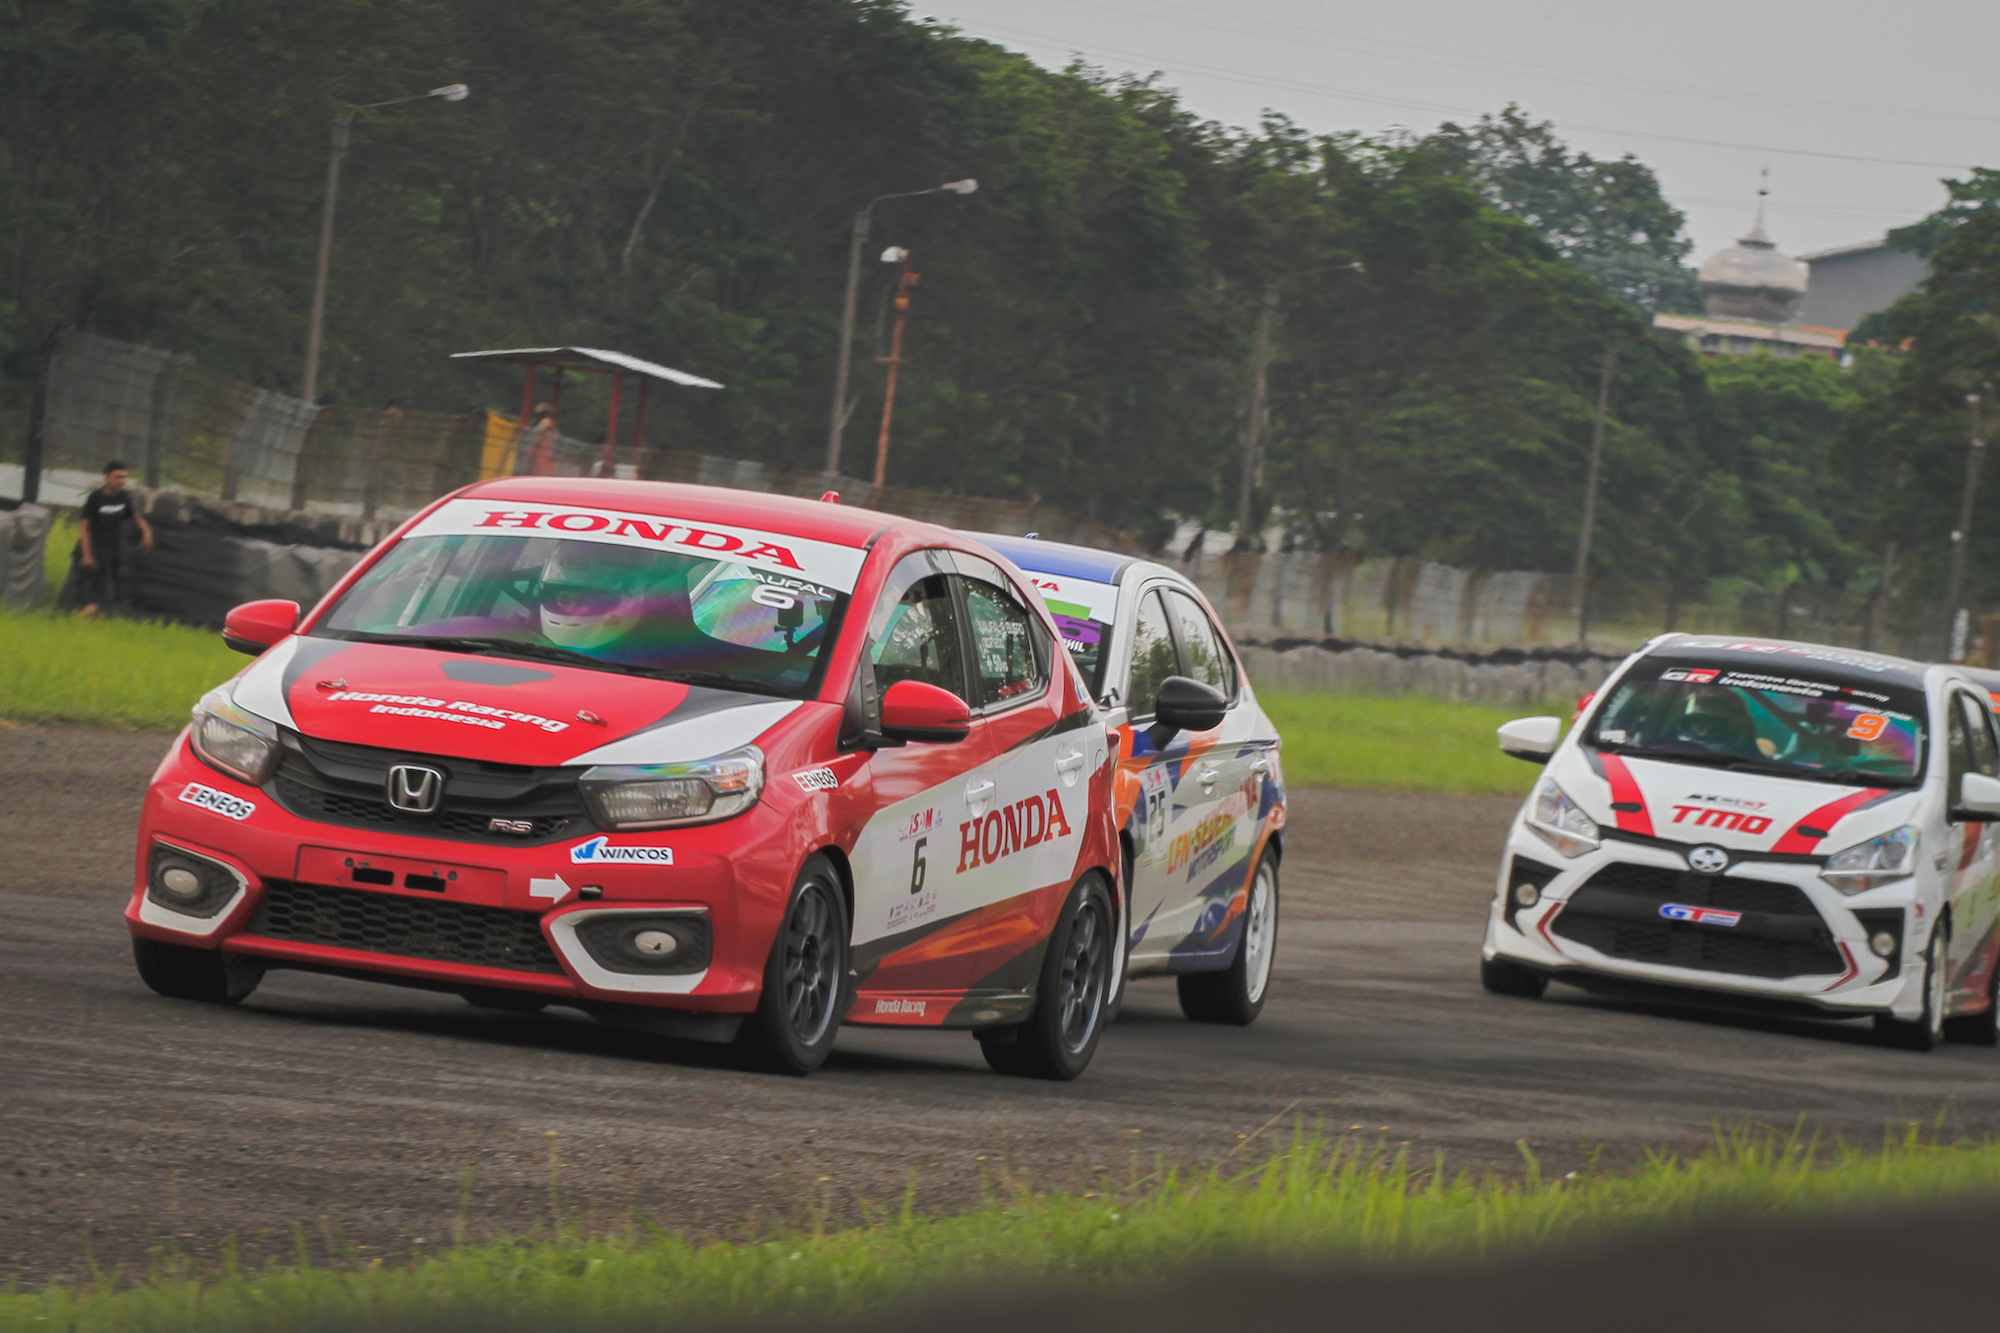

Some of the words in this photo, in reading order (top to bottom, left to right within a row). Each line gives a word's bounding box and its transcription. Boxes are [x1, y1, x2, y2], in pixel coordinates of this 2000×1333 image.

[472, 511, 806, 572] HONDA
[730, 568, 834, 599] NAUFAL
[751, 584, 800, 610] 6
[1718, 676, 1824, 698] Indonesia
[327, 691, 446, 709] Honda
[446, 700, 571, 733] Racing
[369, 703, 507, 730] Indonesia
[1846, 713, 1891, 741] 9
[803, 769, 838, 789] ENEOS
[199, 788, 252, 818] ENEOS
[488, 818, 533, 833] RS
[956, 788, 1072, 875] HONDA
[599, 847, 669, 861] WINCOS
[910, 836, 928, 895] 6
[875, 999, 901, 1014] Honda
[901, 1001, 926, 1017] Racing
